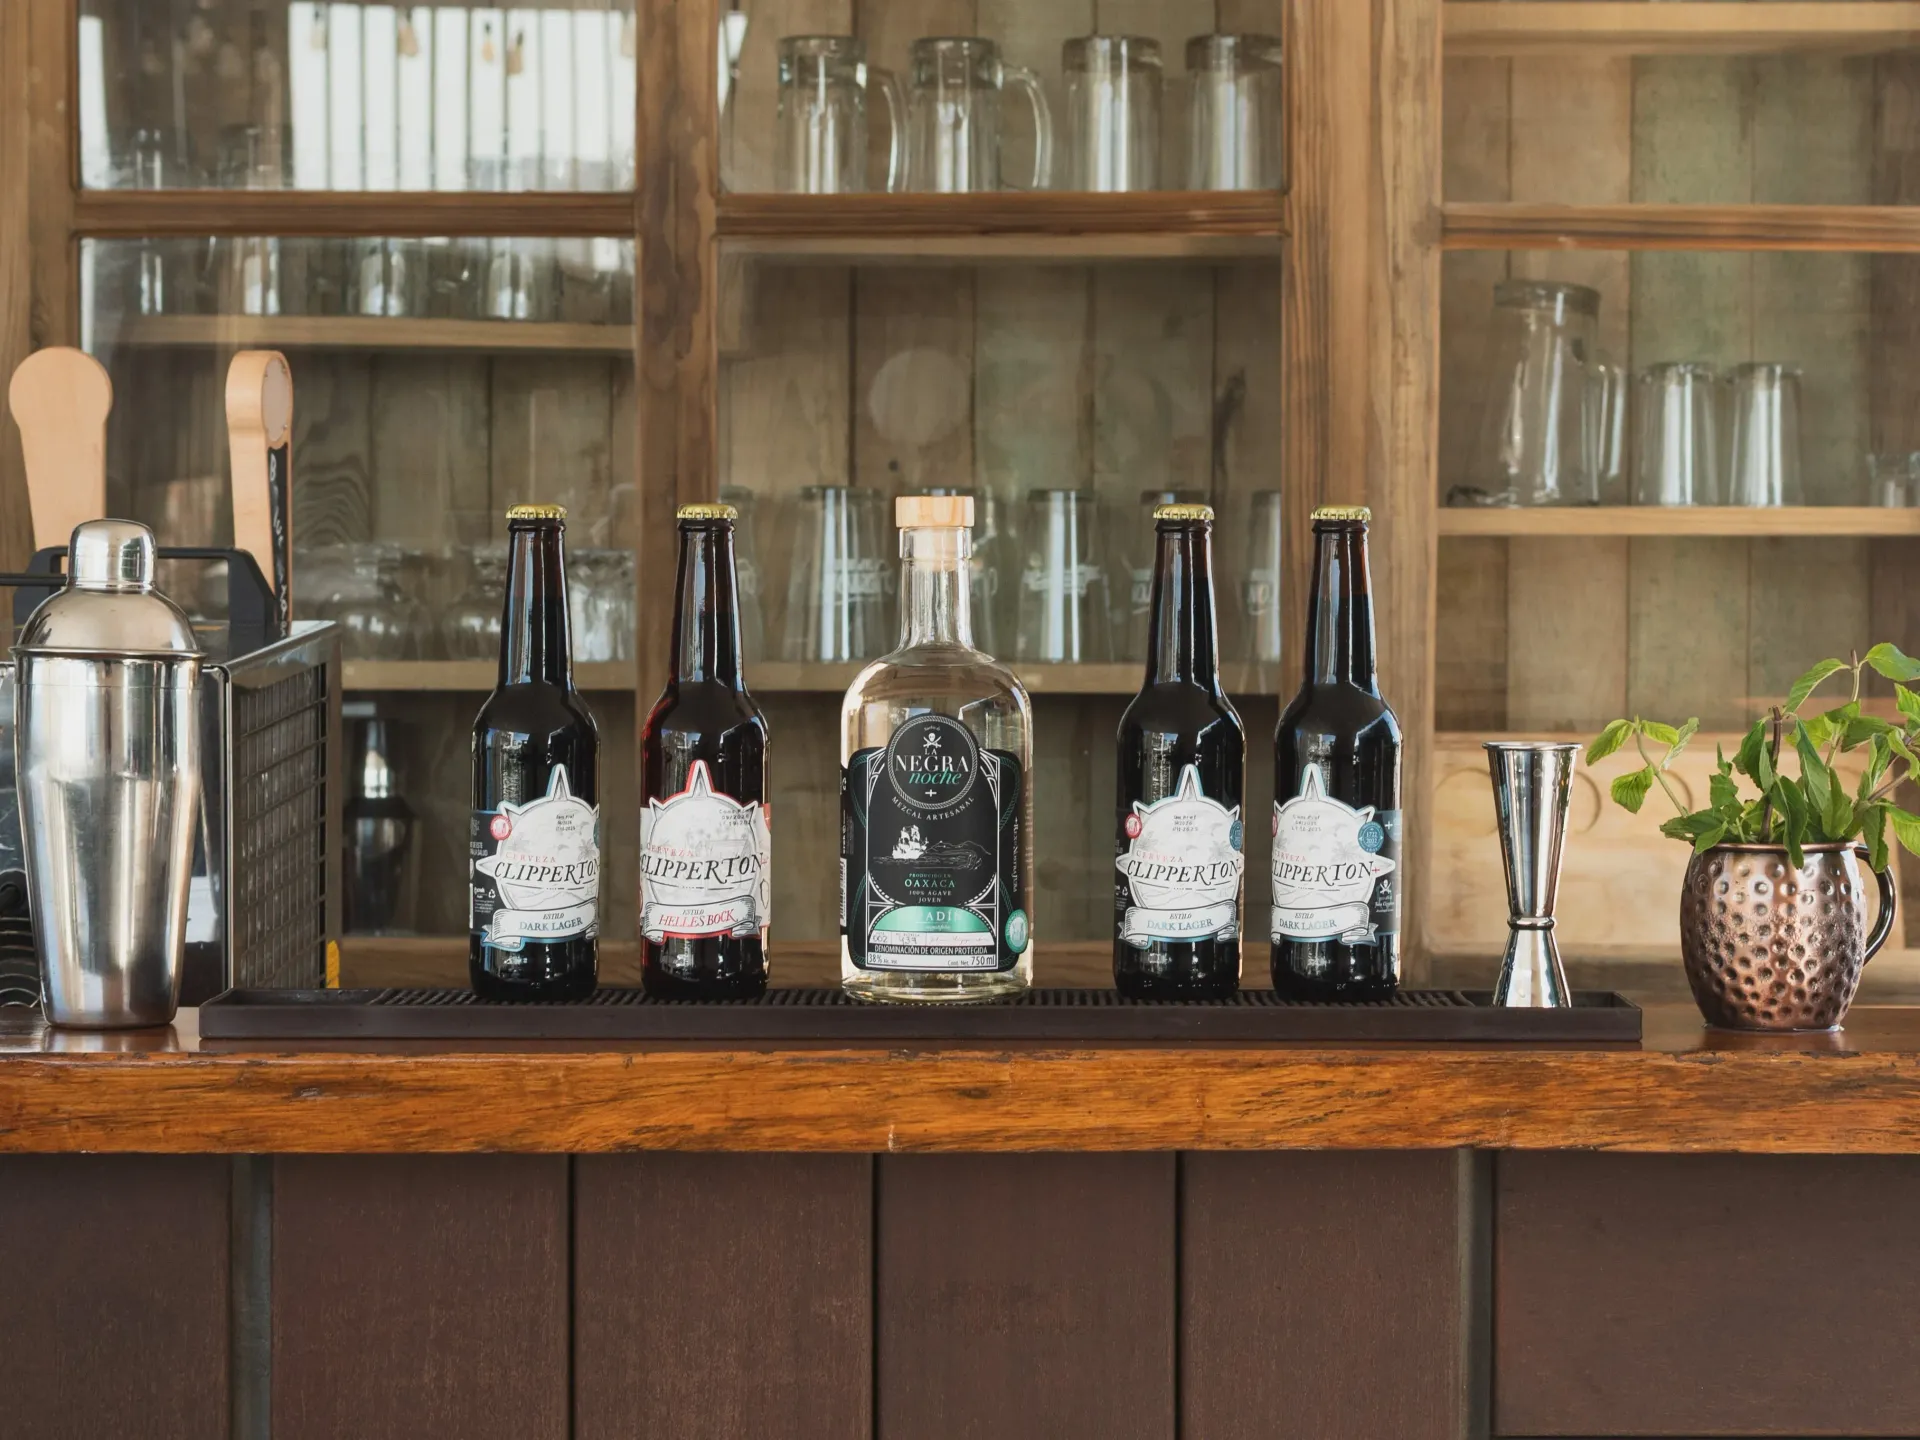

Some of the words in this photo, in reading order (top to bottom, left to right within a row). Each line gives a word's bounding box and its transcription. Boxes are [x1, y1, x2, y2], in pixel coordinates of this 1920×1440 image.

[895, 755, 970, 773] NEGRA
[908, 767, 962, 785] noche
[891, 796, 922, 820] MEZCAL
[925, 796, 975, 821] ARTESANAL
[647, 843, 695, 857] CERVEZA
[1136, 849, 1184, 863] CERVEZA
[505, 852, 556, 863] CERVEZA
[640, 852, 763, 885] CLIPPERTON
[1127, 858, 1240, 886] CLIPPERTON
[904, 878, 956, 888] OAXACA
[519, 921, 549, 931] DARK
[551, 917, 583, 931] LAGER
[658, 914, 705, 928] HELLES
[706, 908, 739, 926] BOCK
[1146, 920, 1176, 931] DARK
[1177, 918, 1214, 931] LAGER
[1279, 918, 1300, 930] DARK
[1301, 918, 1338, 931] LAGER
[874, 944, 920, 954] DENOMINACIÓN
[920, 946, 929, 954] DE
[929, 946, 954, 955] ORIGEN
[971, 956, 985, 966] 750
[986, 955, 995, 965] ml
